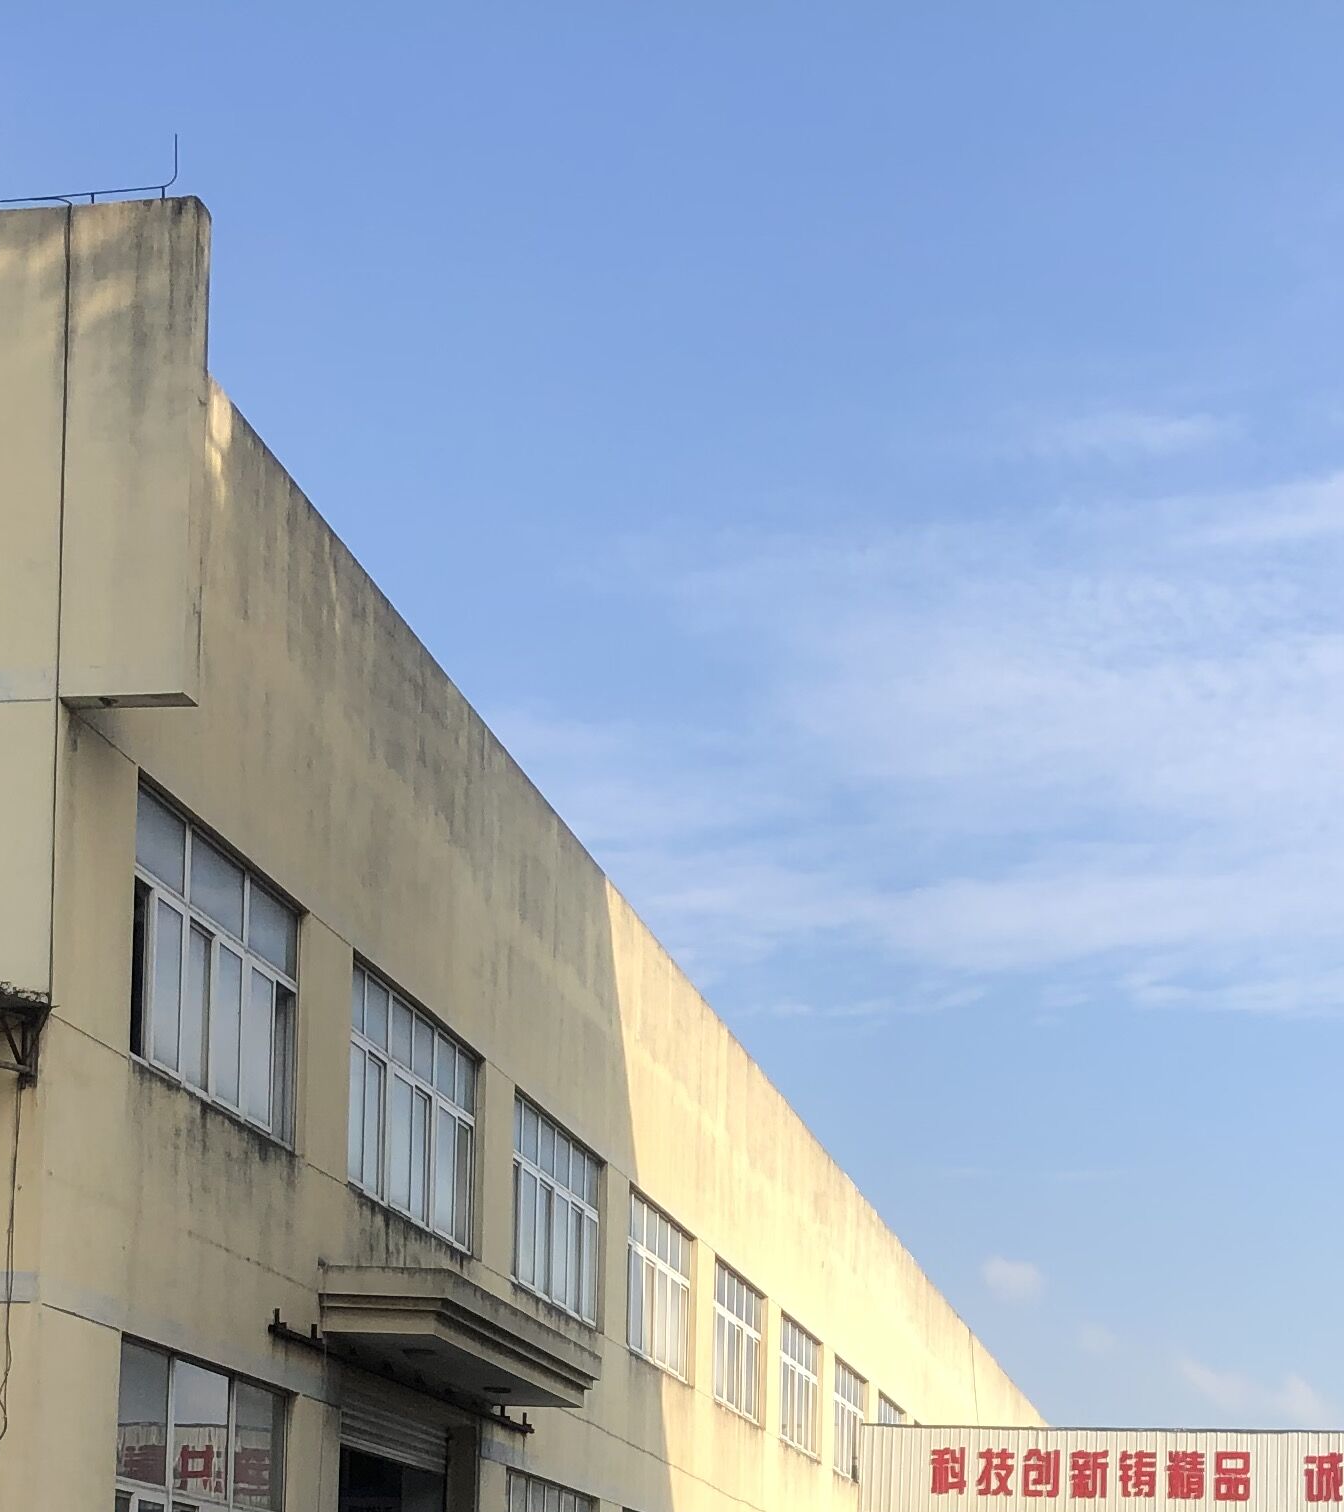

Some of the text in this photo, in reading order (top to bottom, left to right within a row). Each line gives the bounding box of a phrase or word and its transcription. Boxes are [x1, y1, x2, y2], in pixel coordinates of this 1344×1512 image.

[929, 1446, 1251, 1502] 科技创新铸精品
